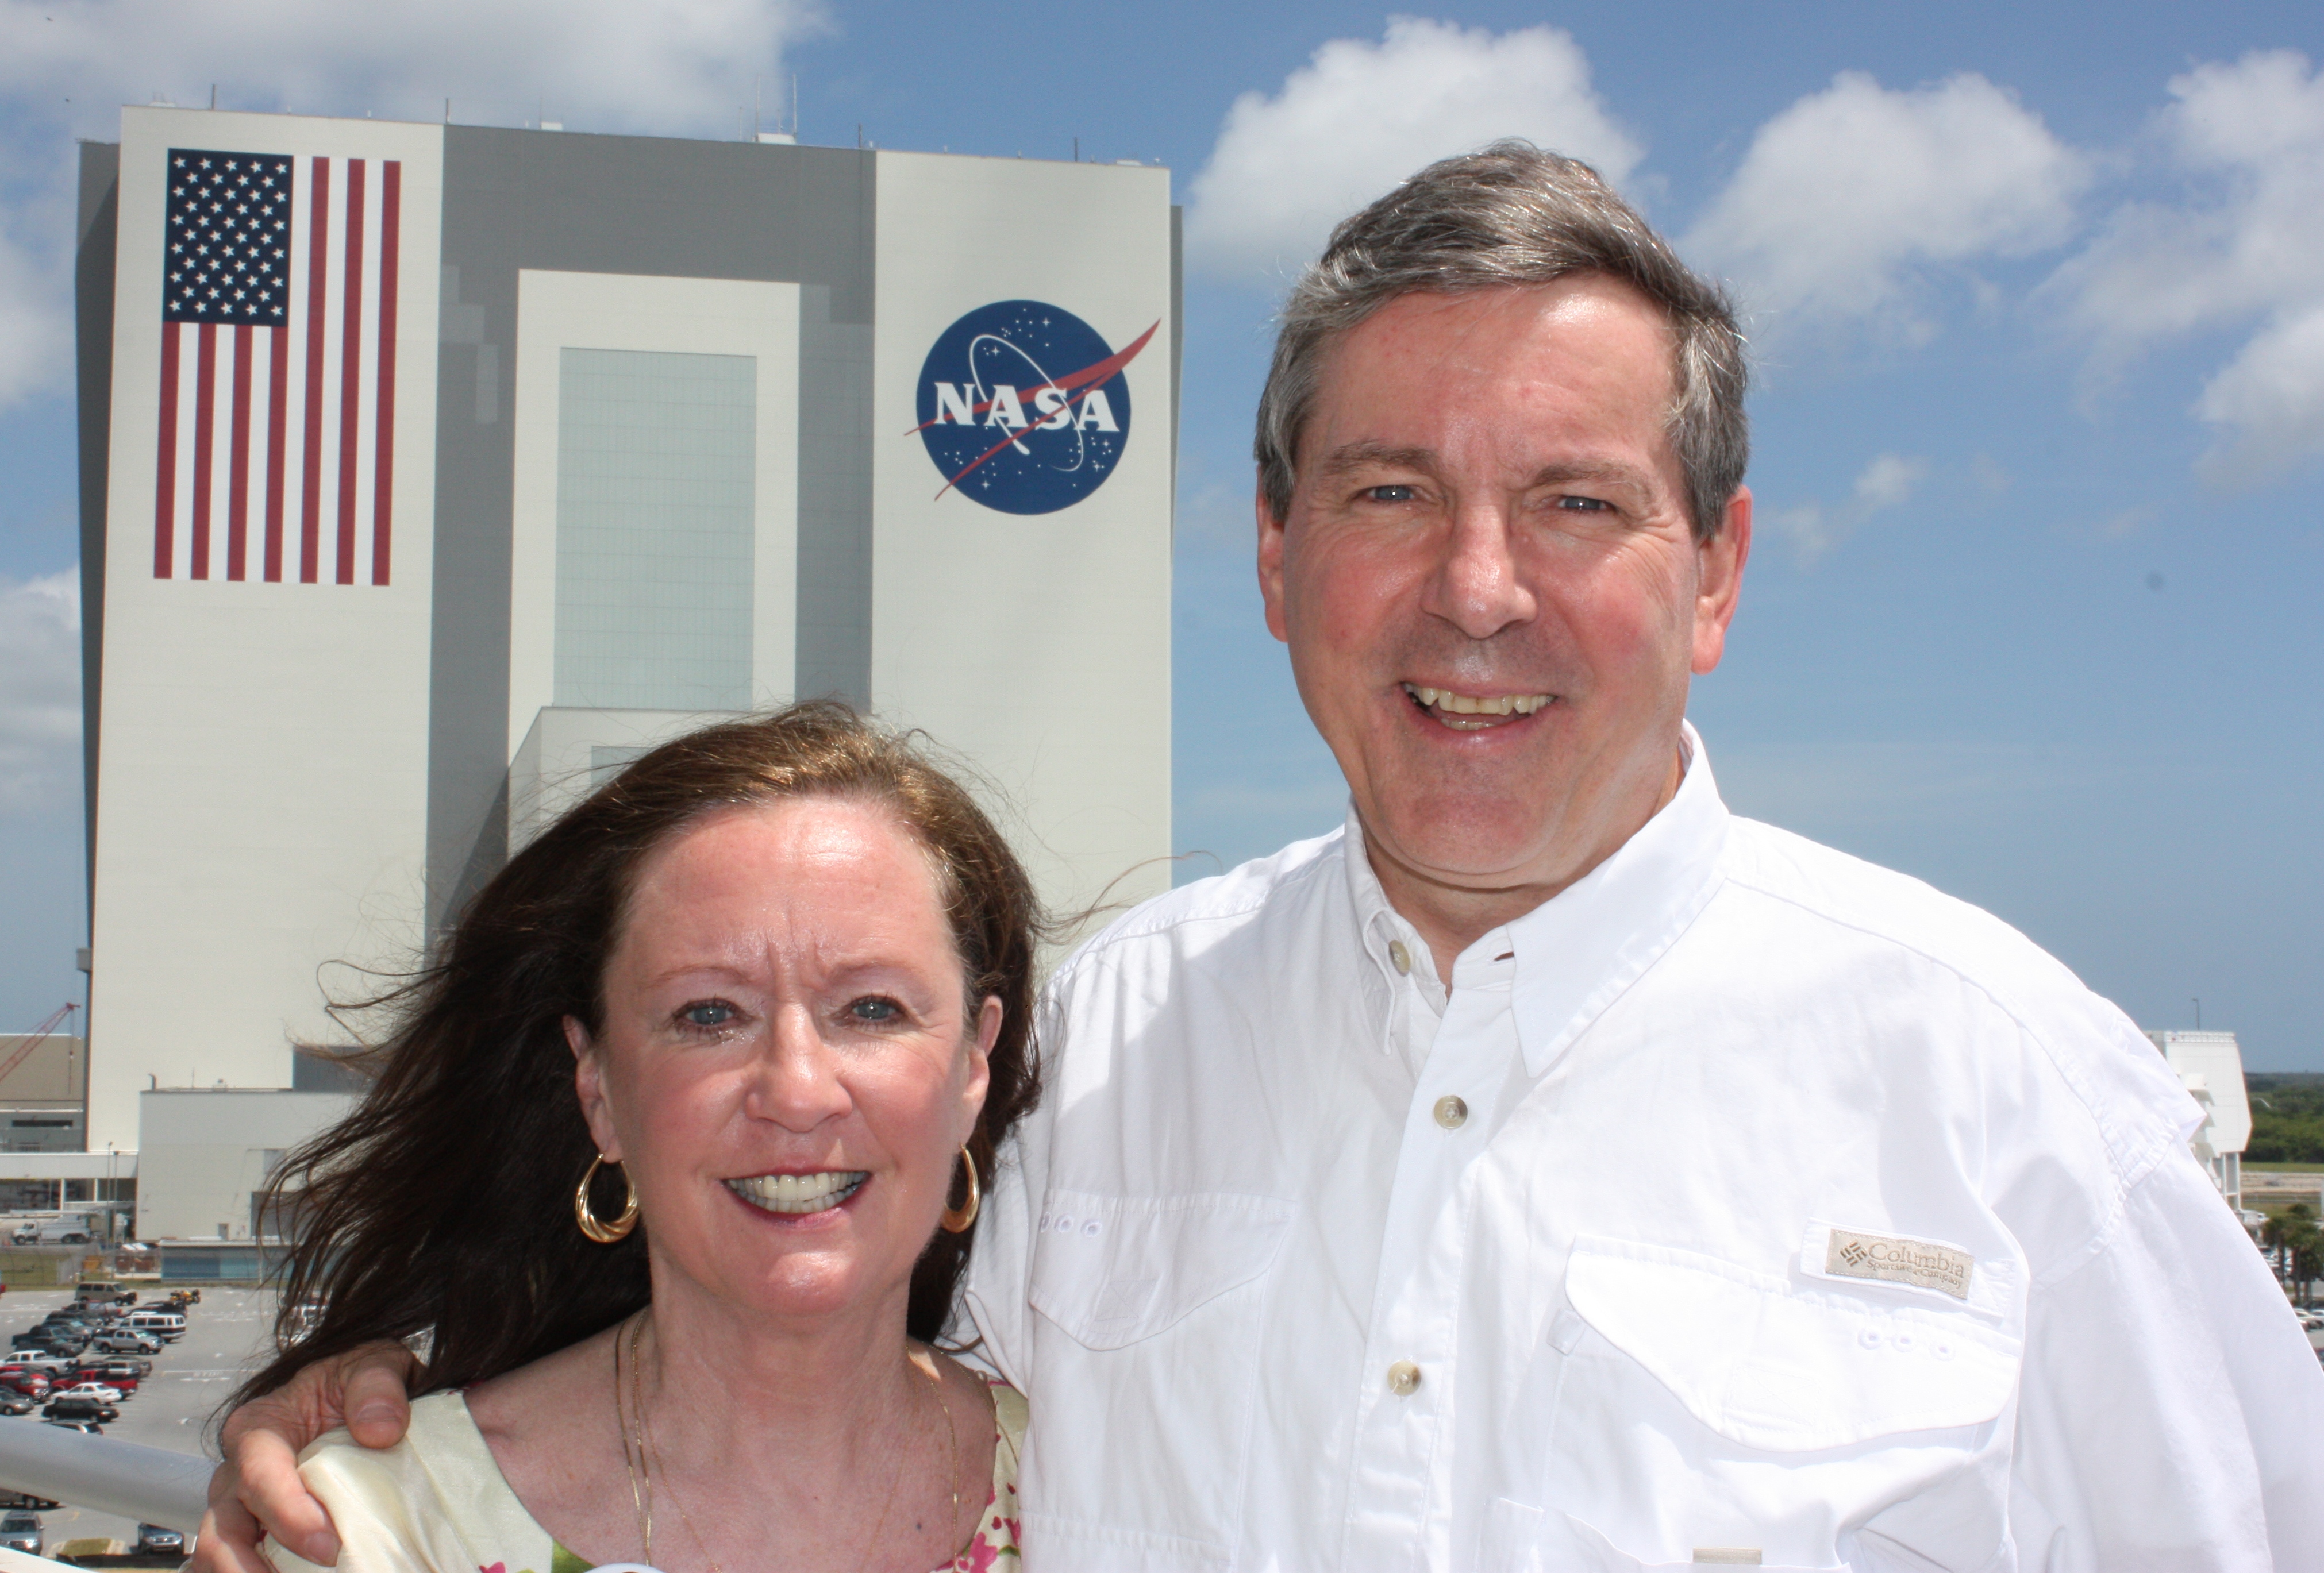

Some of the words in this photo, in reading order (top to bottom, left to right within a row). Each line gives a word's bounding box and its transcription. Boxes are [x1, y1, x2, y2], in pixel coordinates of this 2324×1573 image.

[934, 382, 1120, 432] NASA
[1868, 1243, 1964, 1278] Columbia
[1920, 1269, 1961, 1289] Company
